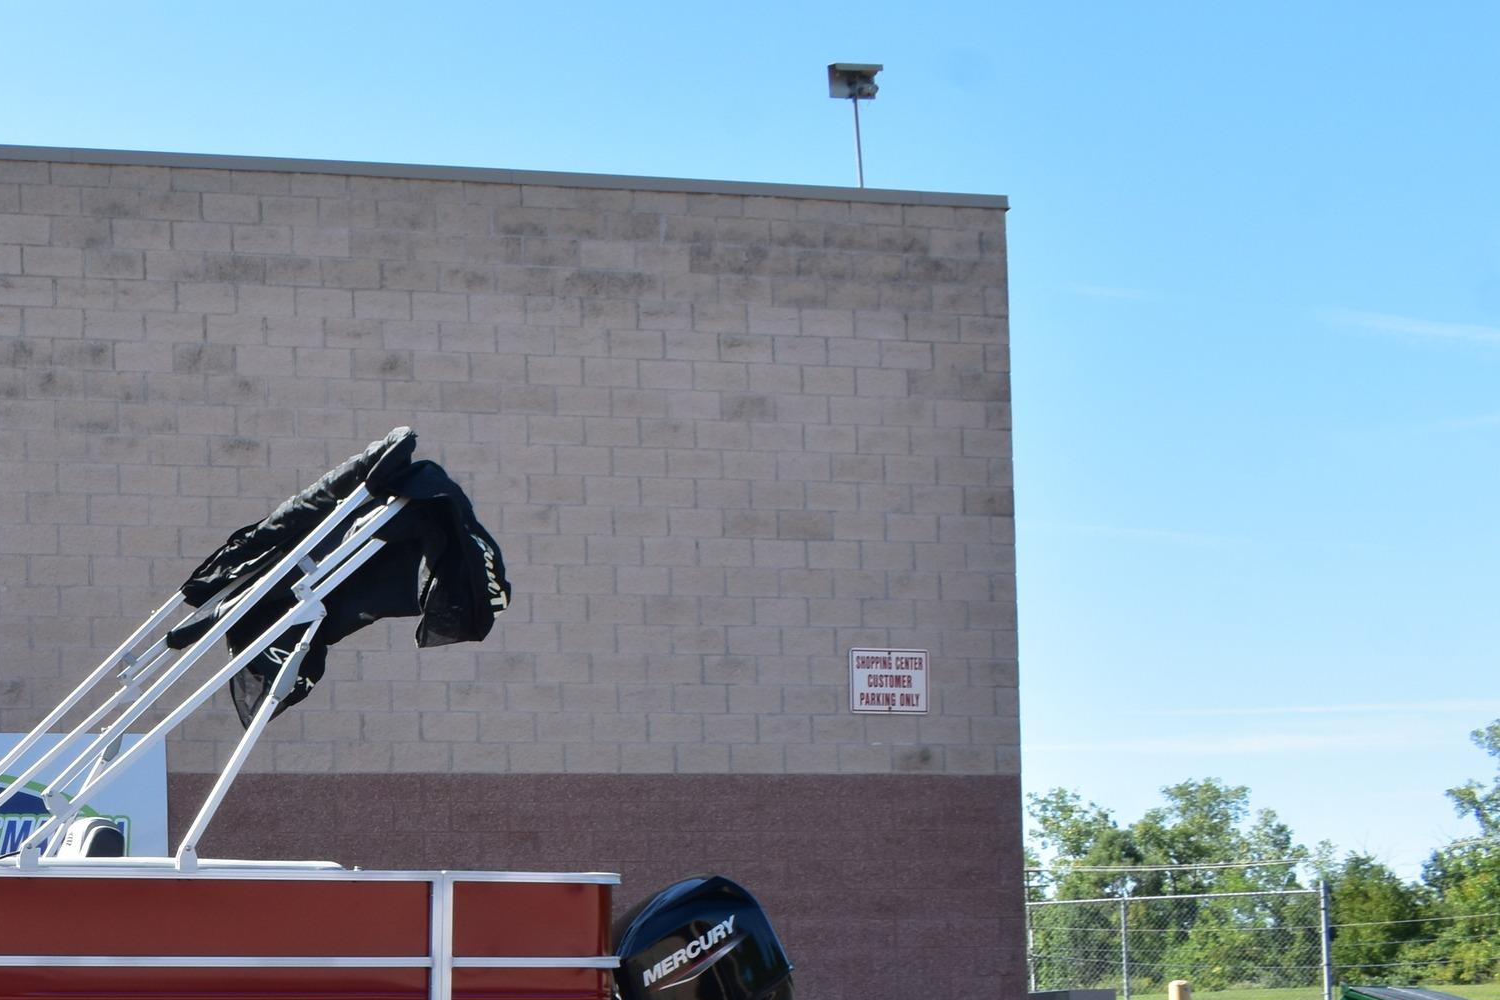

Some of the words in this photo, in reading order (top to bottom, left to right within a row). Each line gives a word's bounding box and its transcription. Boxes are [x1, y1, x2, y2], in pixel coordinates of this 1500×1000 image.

[856, 656, 892, 669] SHOPPING
[895, 657, 923, 670] CENTER
[868, 674, 912, 688] CUSTOMER
[860, 693, 896, 706] PARKING
[900, 693, 920, 706] ONLY
[643, 915, 735, 987] MERCURY
